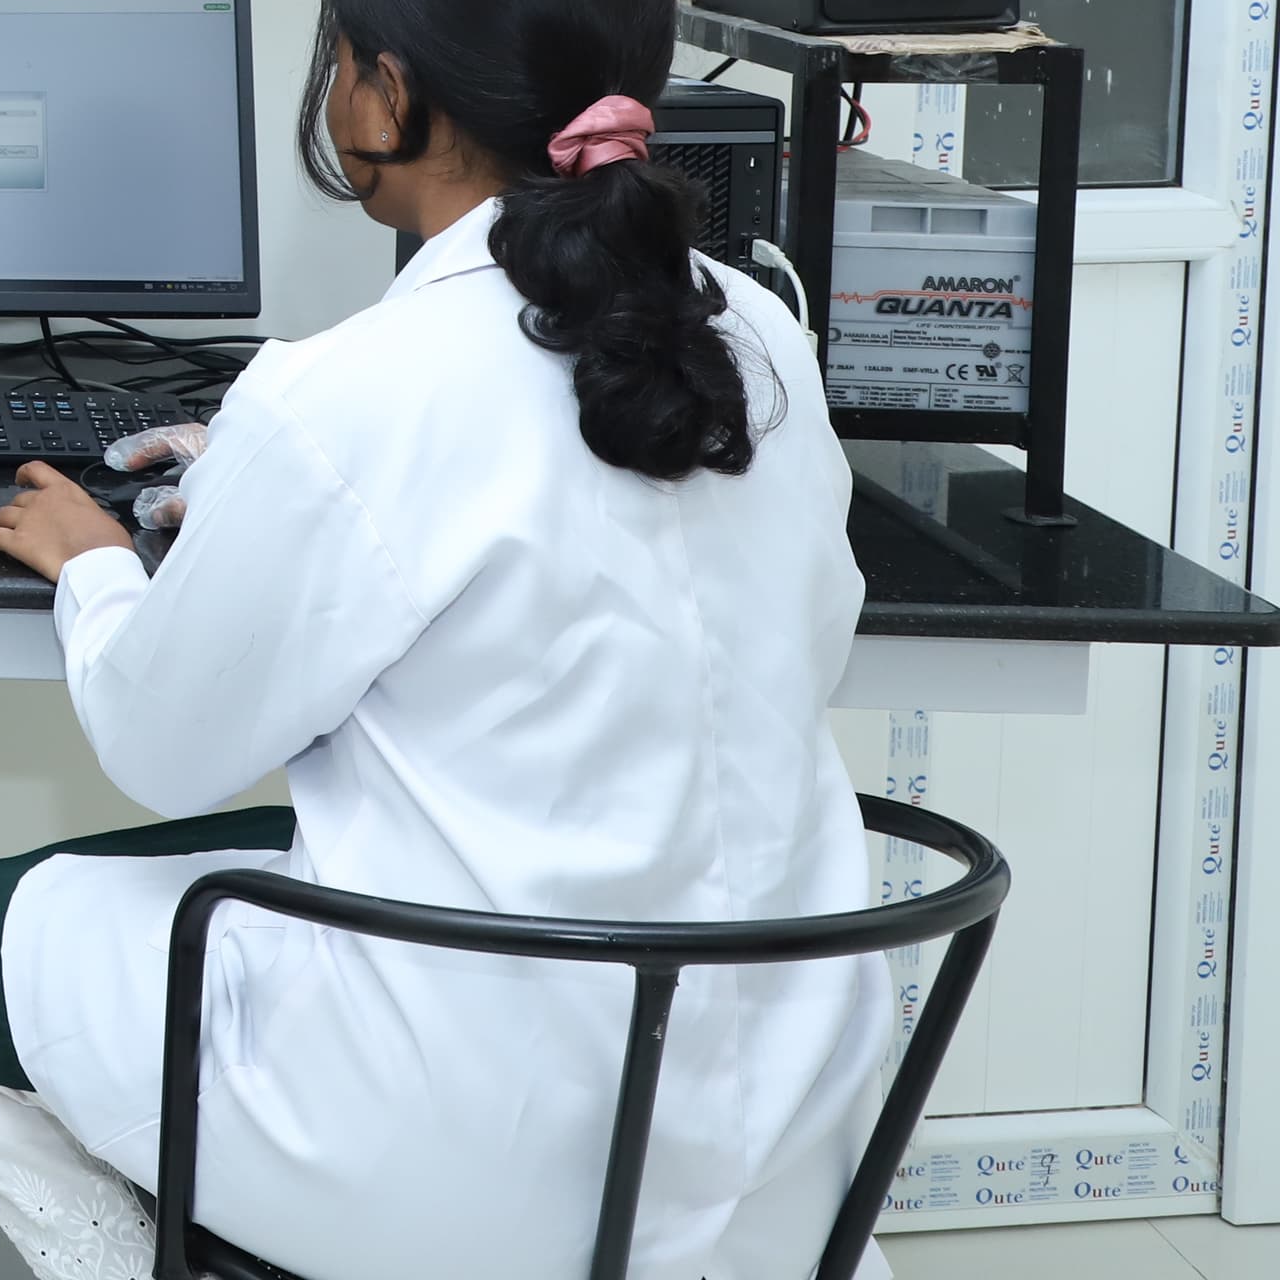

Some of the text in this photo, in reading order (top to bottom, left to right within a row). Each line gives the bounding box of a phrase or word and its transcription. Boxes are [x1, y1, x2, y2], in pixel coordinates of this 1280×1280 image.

[1242, 79, 1263, 130] Qute
[875, 297, 1014, 319] QUANTA
[922, 276, 1014, 294] AMARON
[1231, 295, 1251, 346] Qute
[1225, 402, 1245, 453] Qute
[1220, 509, 1239, 560] Qute
[1208, 720, 1228, 770] Qute
[1202, 824, 1222, 874] Qute
[1197, 928, 1216, 978] Qute
[1191, 1031, 1211, 1081] Qute
[977, 1155, 1025, 1176] Qute
[1075, 1148, 1123, 1170] Qute
